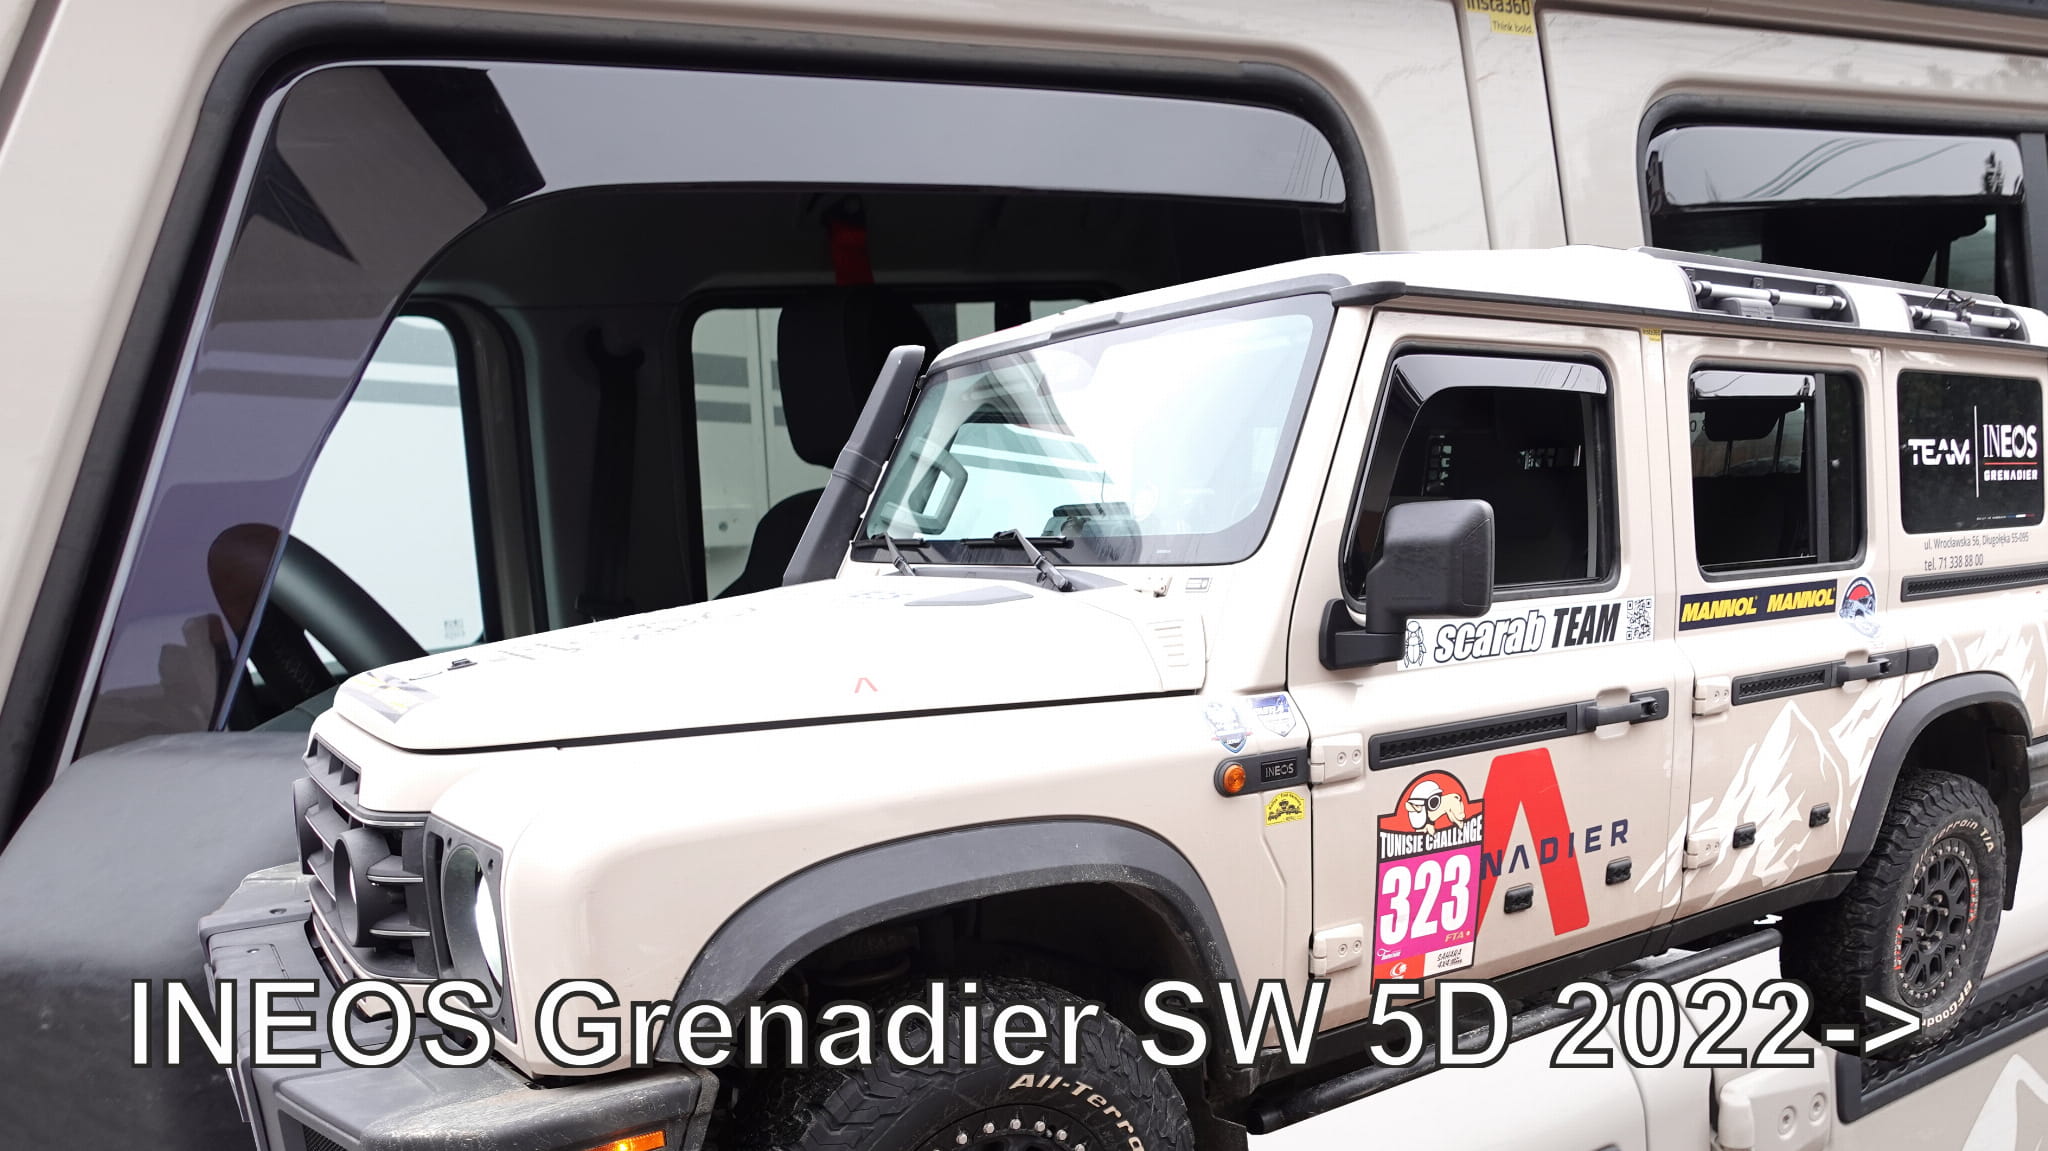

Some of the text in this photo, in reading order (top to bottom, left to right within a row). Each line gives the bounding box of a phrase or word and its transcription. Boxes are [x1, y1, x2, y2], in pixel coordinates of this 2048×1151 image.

[1908, 438, 1971, 466] TEAM
[1982, 424, 2038, 459] INEOS
[1983, 469, 2038, 481] GRENADIER
[1924, 541, 1933, 551] ul.
[1924, 553, 1984, 571] tel. 71 338 88 00
[1681, 598, 1757, 623] MANNOL
[1766, 588, 1835, 613] MANNOL
[1433, 602, 1622, 664] scarab TEAM
[1265, 763, 1295, 778] INEOS
[1379, 814, 1483, 859] TUNISIE CHALLENGE
[1980, 827, 1994, 853] T/A
[1379, 854, 1472, 946] 323
[1444, 931, 1465, 943] FTA
